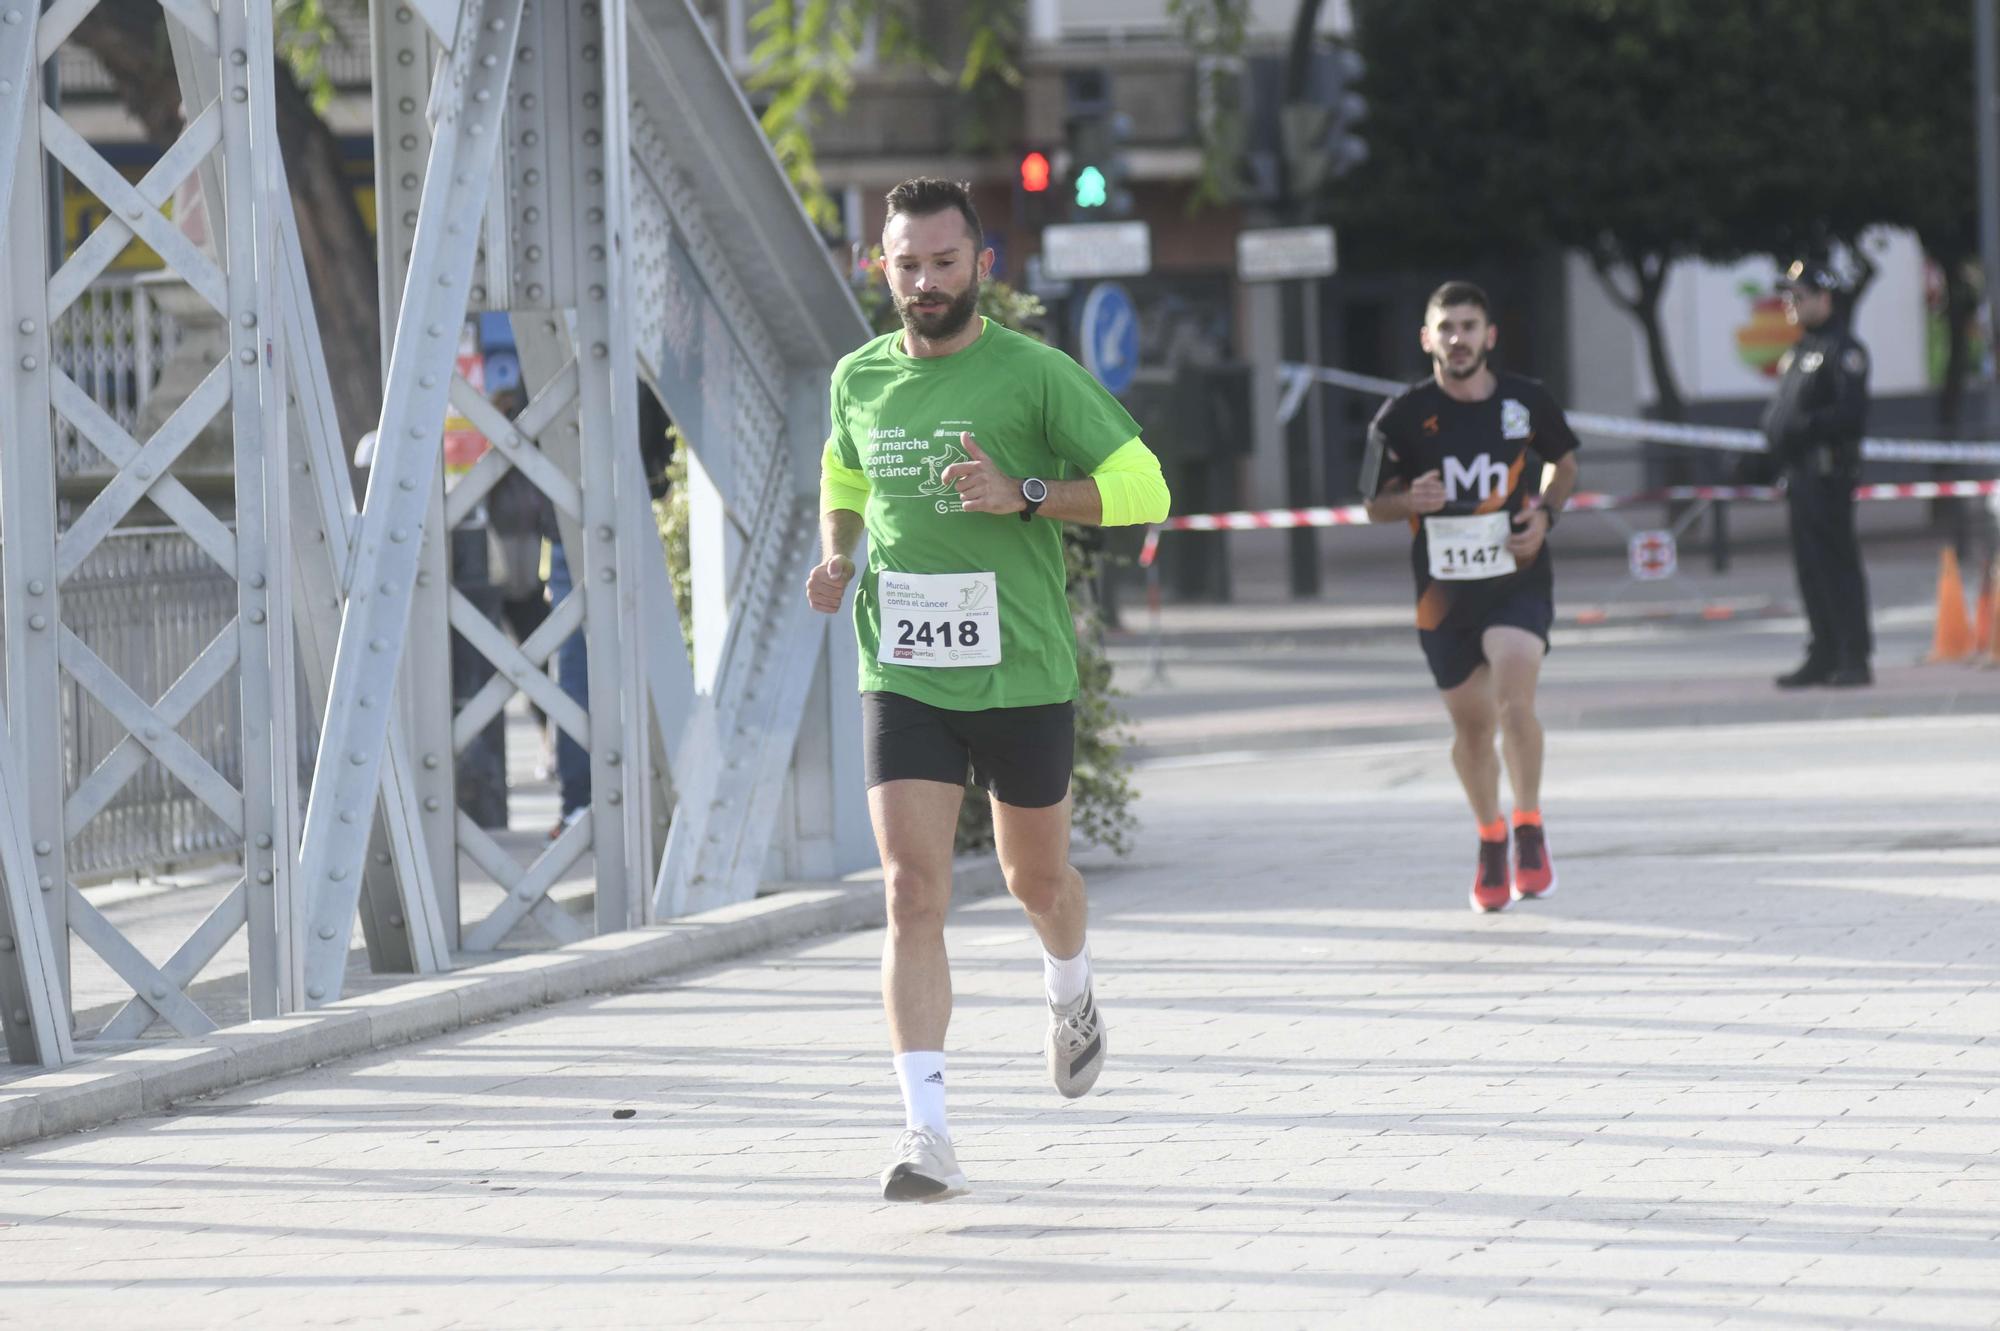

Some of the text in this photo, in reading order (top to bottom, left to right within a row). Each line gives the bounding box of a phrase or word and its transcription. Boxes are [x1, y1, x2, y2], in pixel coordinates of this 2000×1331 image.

[868, 426, 905, 439] Murcia
[882, 438, 929, 451] marcha
[867, 453, 904, 465] contra
[869, 465, 922, 478] el cáncer
[1444, 545, 1500, 565] 1147
[886, 582, 910, 590] Murcia
[897, 591, 925, 600] marcha
[887, 598, 910, 606] contra
[919, 600, 948, 608] cáncer
[897, 620, 980, 647] 2418
